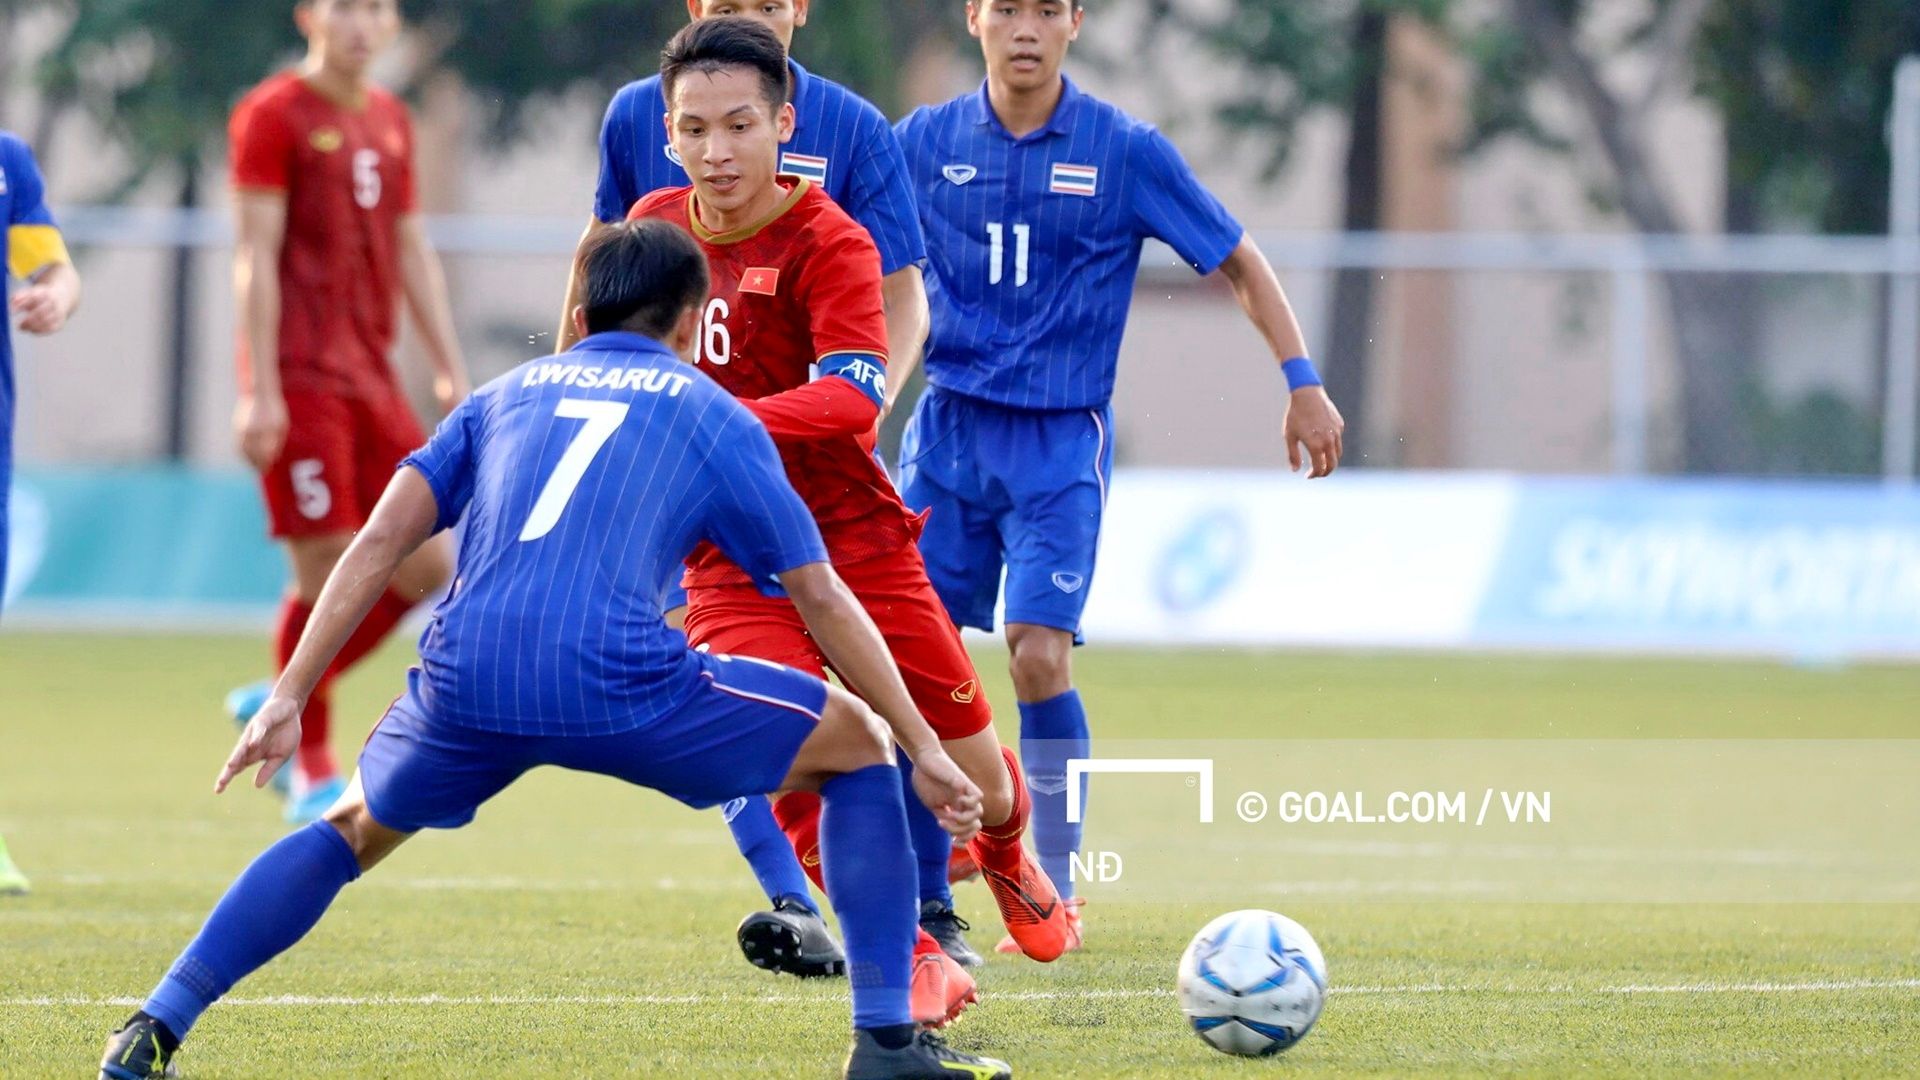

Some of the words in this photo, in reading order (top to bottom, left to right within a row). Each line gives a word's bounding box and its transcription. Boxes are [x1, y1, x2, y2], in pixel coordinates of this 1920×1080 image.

[353, 147, 382, 210] 5
[986, 222, 1030, 287] 11
[289, 459, 332, 519] 5
[518, 398, 630, 542] 7
